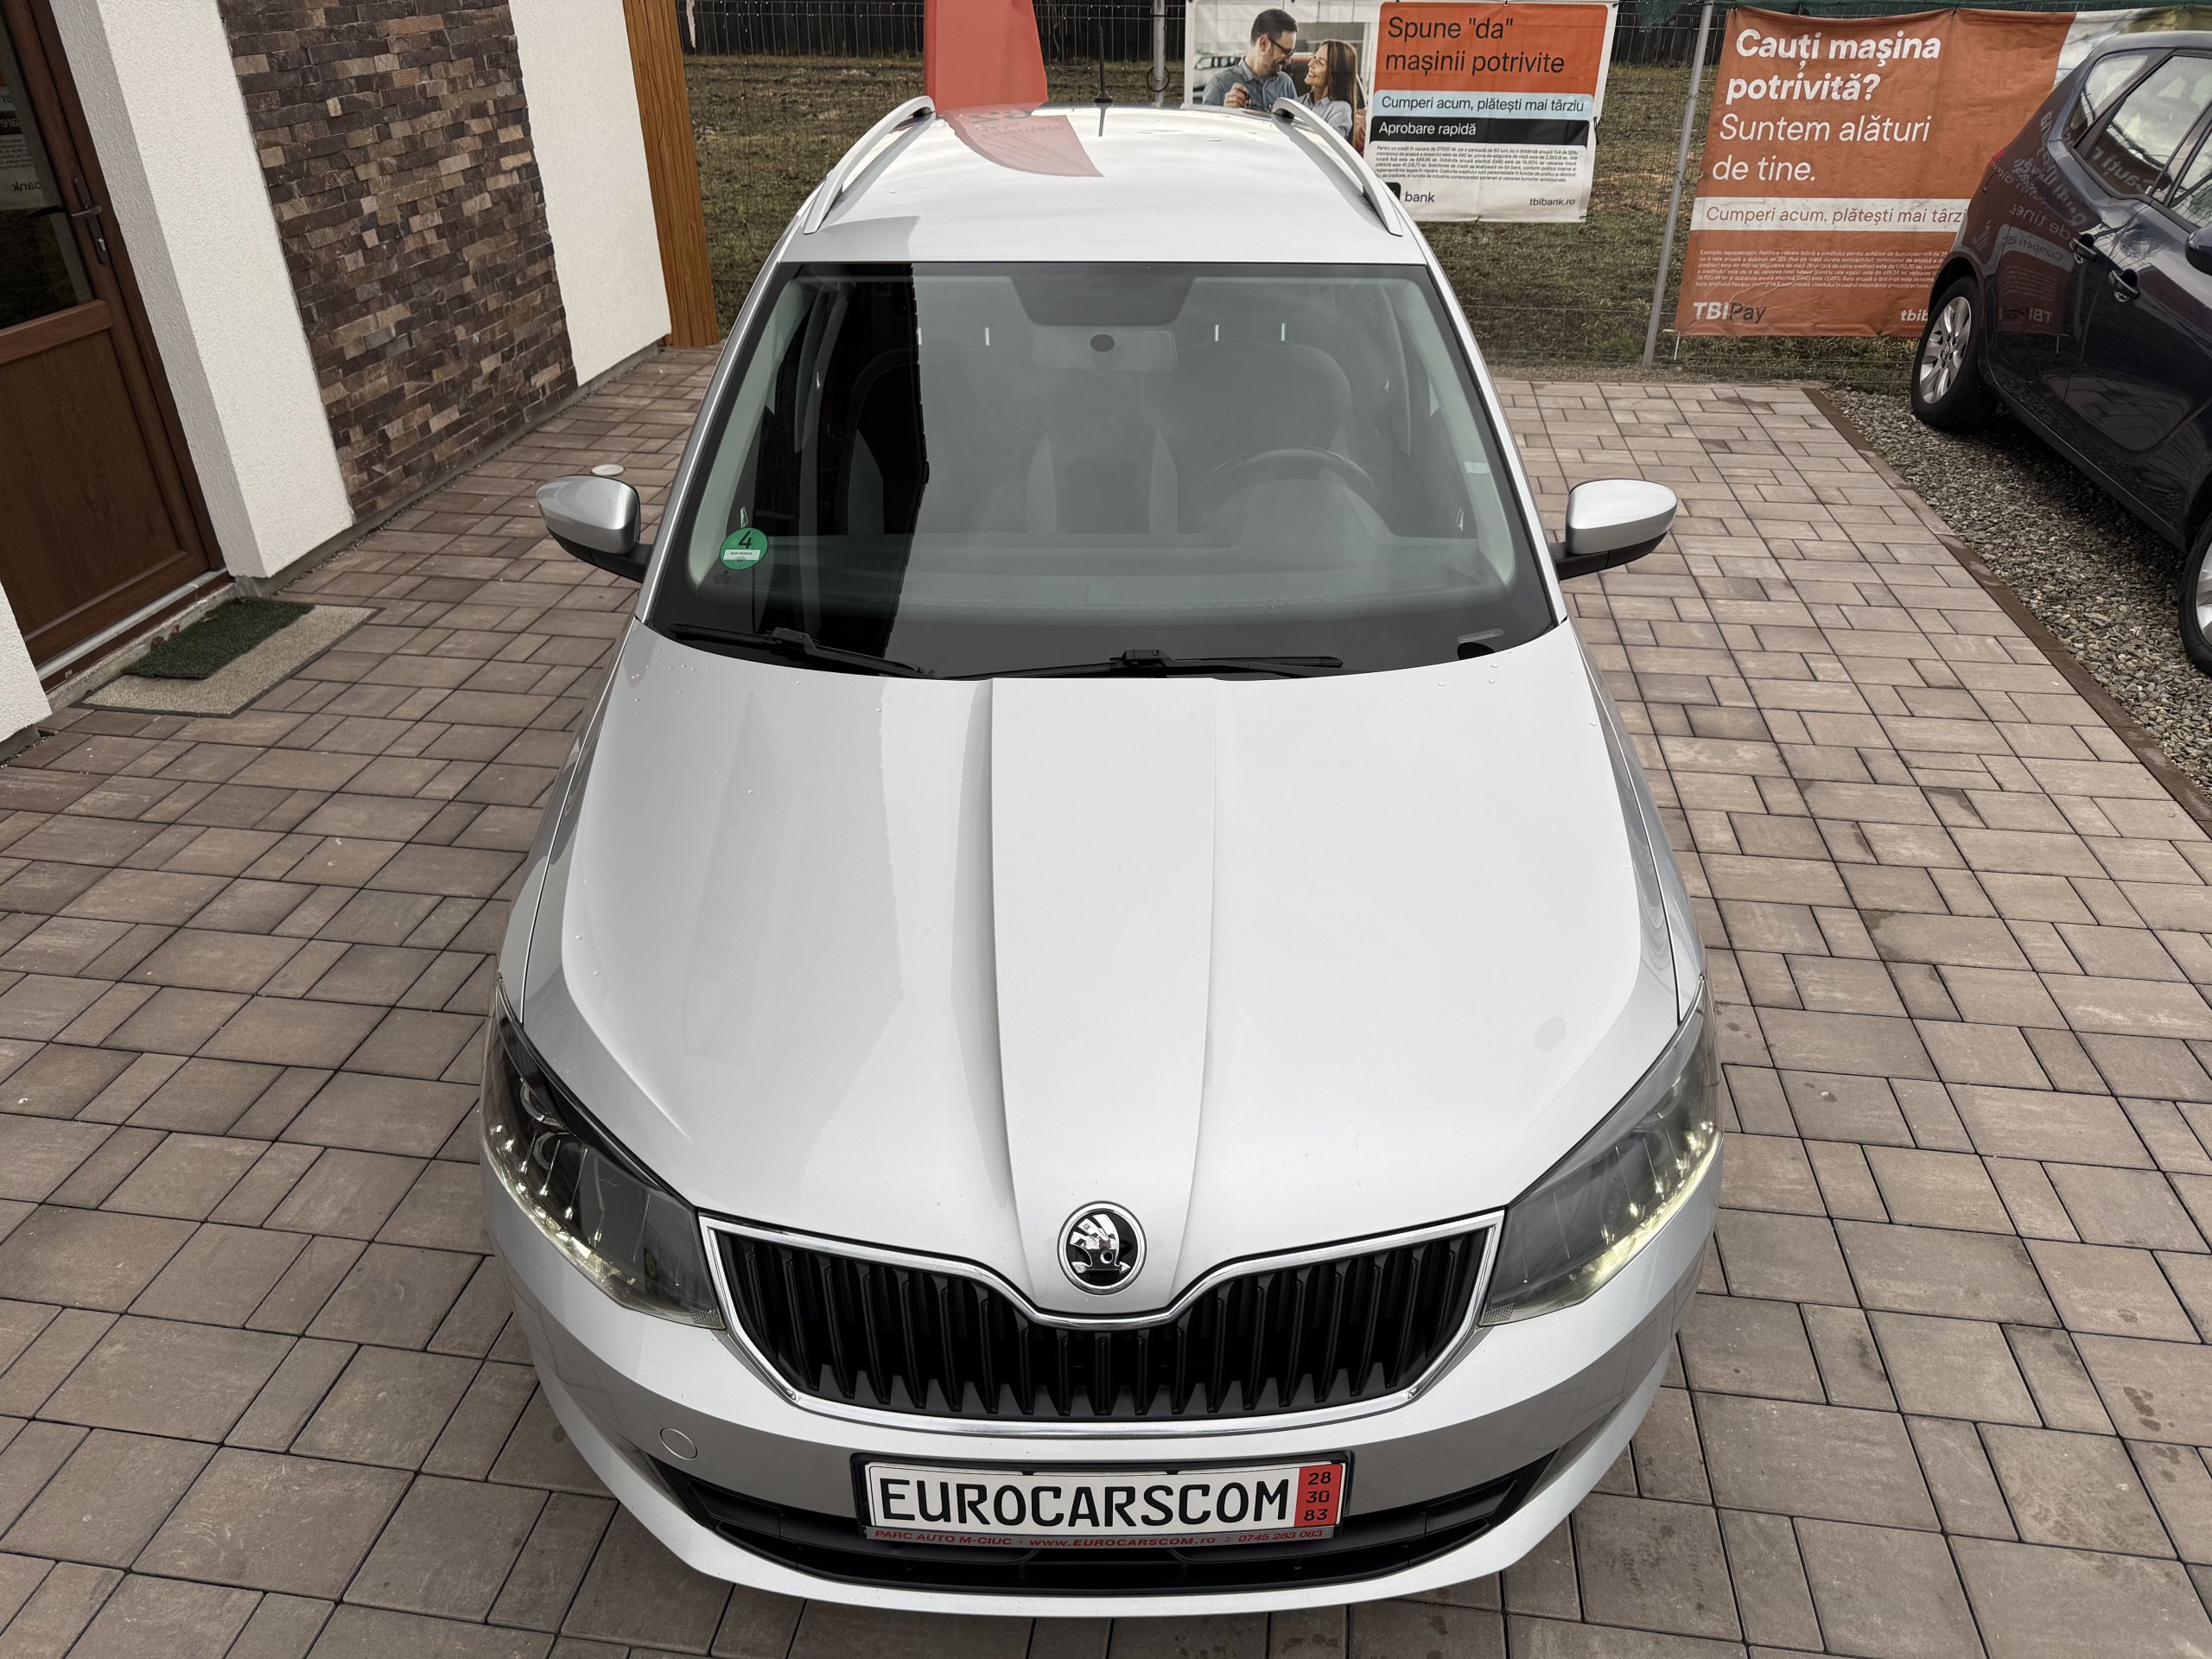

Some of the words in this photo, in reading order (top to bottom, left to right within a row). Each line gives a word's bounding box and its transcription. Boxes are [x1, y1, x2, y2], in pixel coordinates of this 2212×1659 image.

[1388, 17, 1461, 41] Spune
[1469, 17, 1514, 40] "da"
[1736, 29, 1822, 69] Cauți
[1385, 51, 1465, 75] mașinii
[1472, 52, 1566, 75] potrivite
[1726, 73, 1881, 105] potrivită?
[1382, 95, 1433, 112] Cumperi
[1437, 99, 1473, 111] acum,
[1477, 97, 1524, 114] plătești
[1525, 99, 1548, 112] mai
[1551, 99, 1585, 112] târziu
[1378, 121, 1435, 138] Aprobare
[1438, 122, 1477, 138] rapidă
[1719, 113, 1829, 142] Suntem
[1839, 116, 1931, 142] alături
[1713, 155, 1750, 181] de
[1757, 156, 1815, 181] tine.
[1405, 192, 1435, 203] bank
[1529, 197, 1576, 207] tbibank.ro
[1706, 207, 1776, 225] Cumperi
[1779, 210, 1827, 225] acum,
[1897, 208, 1926, 222] mai
[1932, 208, 1967, 222] târzi
[1693, 302, 1766, 323] TBIPay
[738, 531, 752, 549] 4
[1307, 1471, 1332, 1485] 28
[880, 1477, 1291, 1528] EUROCARSCOM
[1306, 1491, 1330, 1503] 30
[1304, 1509, 1328, 1522] 83
[874, 1530, 912, 1540] PARC
[916, 1533, 955, 1542] AUTO
[959, 1535, 1012, 1545] M-CIUC
[1029, 1536, 1216, 1547] www.EUROCARSCOM.ro
[1238, 1533, 1269, 1542] 0745
[1272, 1531, 1297, 1540] 283
[1300, 1529, 1324, 1538] 083
